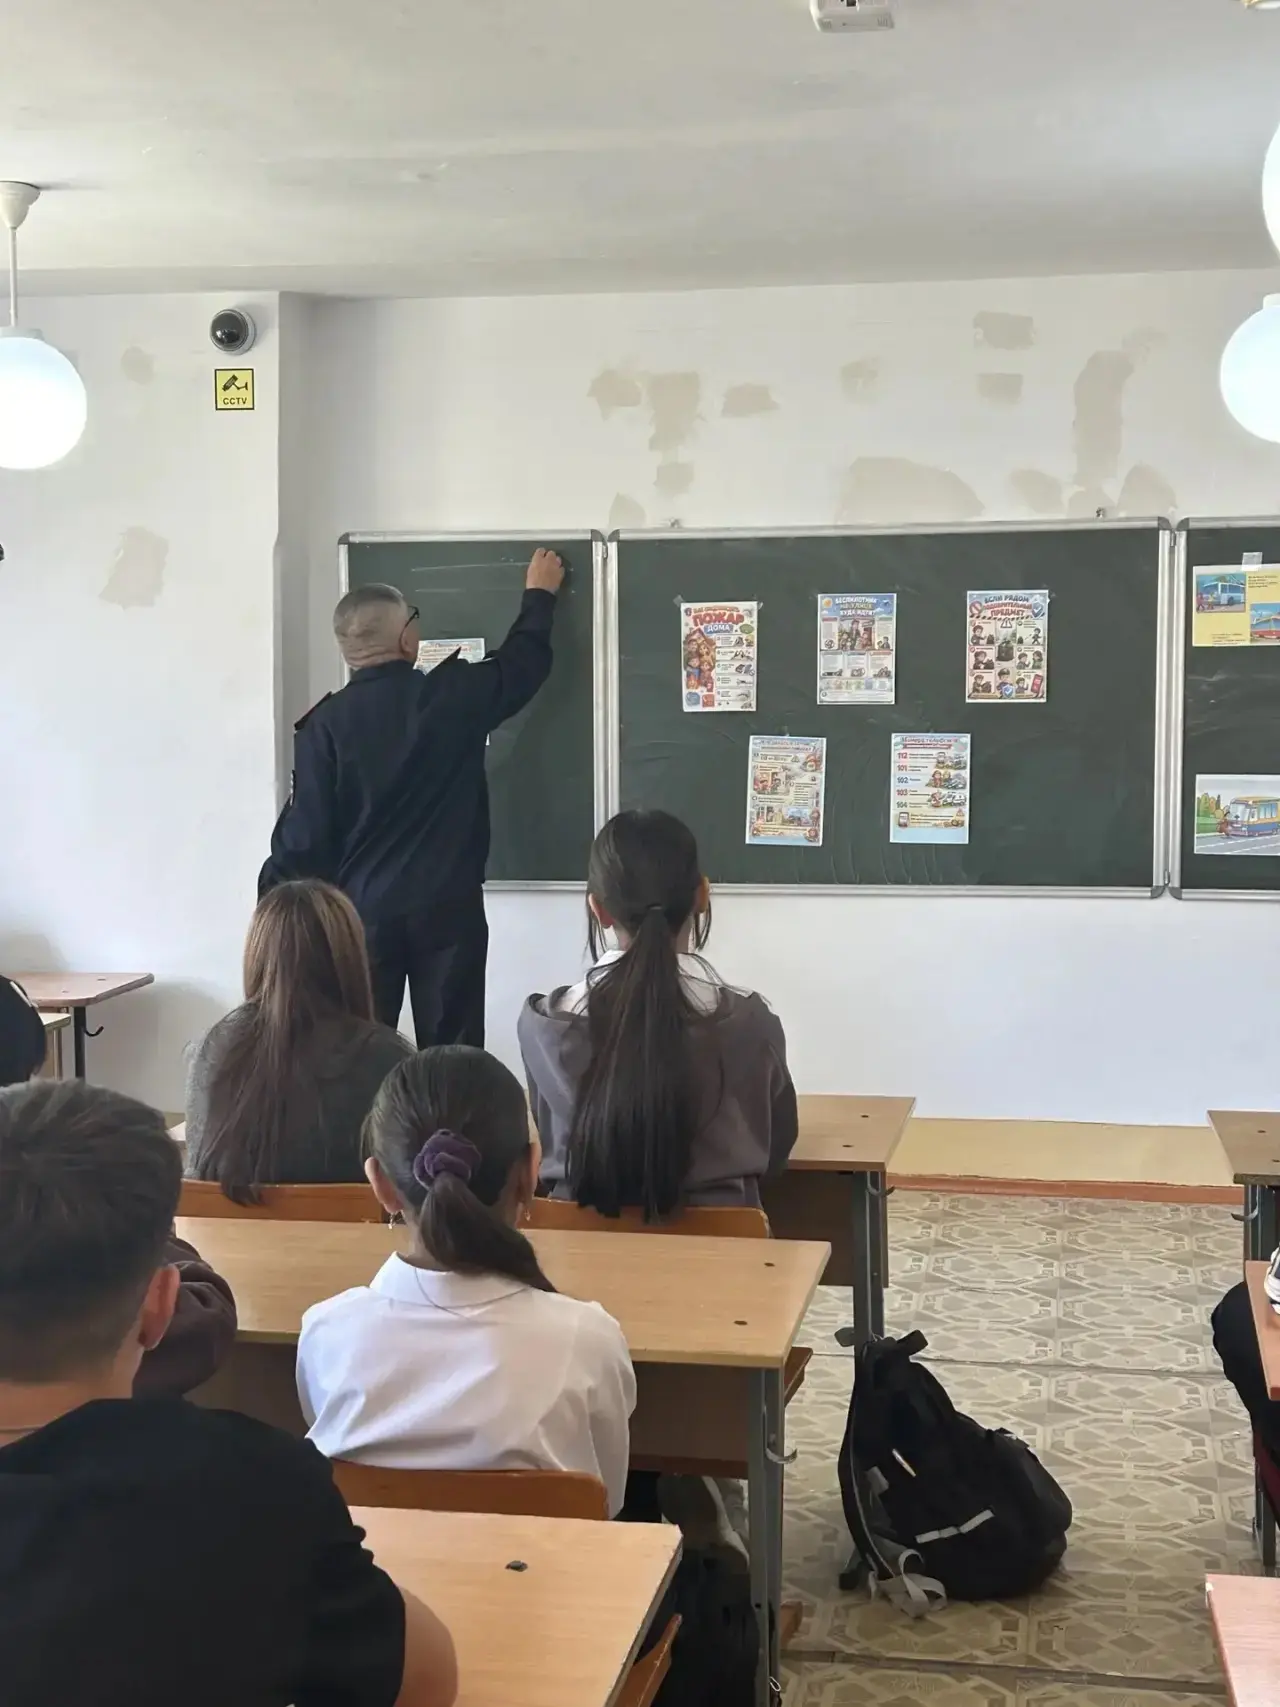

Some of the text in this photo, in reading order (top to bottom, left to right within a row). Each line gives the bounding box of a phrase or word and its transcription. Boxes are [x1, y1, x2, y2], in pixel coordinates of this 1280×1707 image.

[223, 397, 247, 405] CCTV
[692, 612, 744, 627] ПОЖАР
[707, 624, 730, 632] ДОМА
